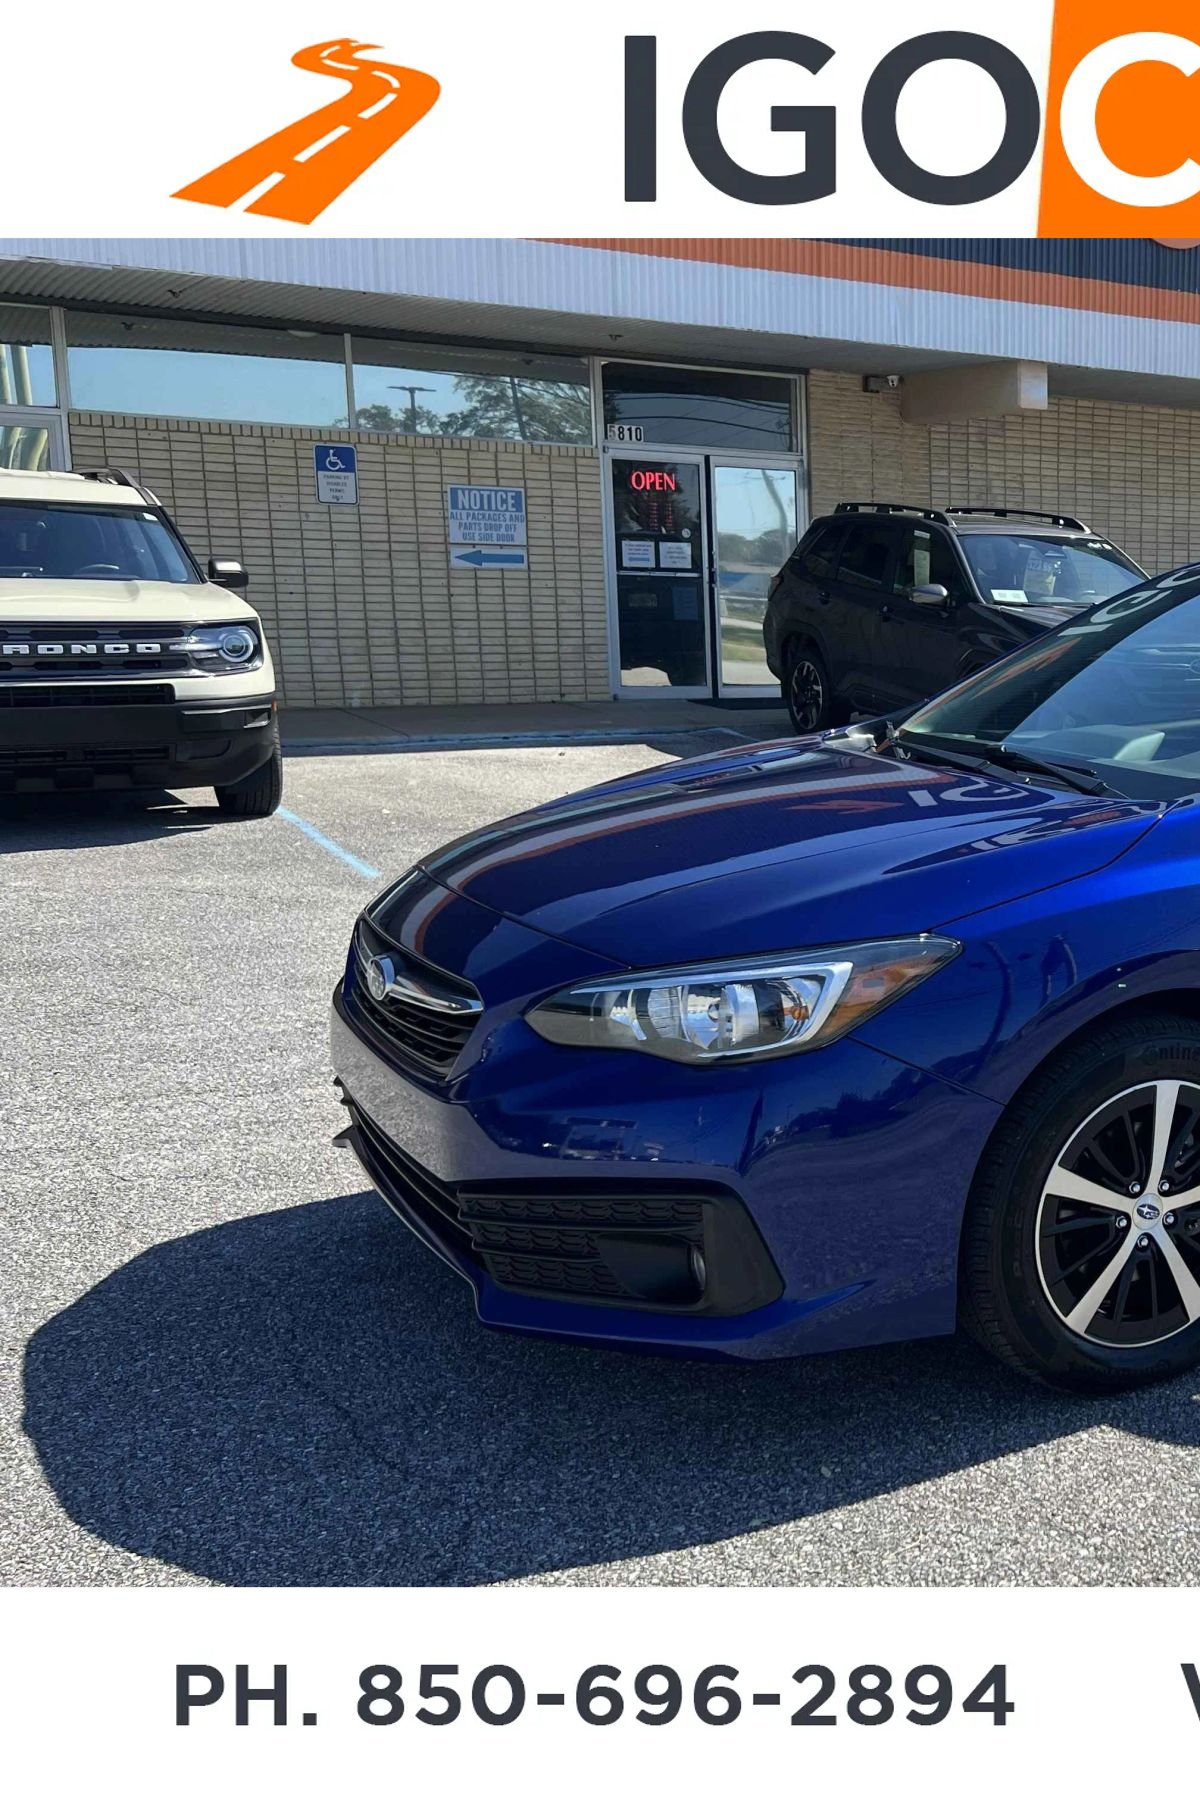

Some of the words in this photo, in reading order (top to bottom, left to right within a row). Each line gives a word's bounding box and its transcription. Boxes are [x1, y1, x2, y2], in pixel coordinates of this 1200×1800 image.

[608, 425, 642, 441] 5810
[630, 471, 677, 491] OPEN
[457, 489, 516, 511] NOTICE
[450, 511, 463, 520] ALL
[466, 511, 507, 522] PACKAGES
[509, 514, 525, 523] AND
[459, 521, 482, 531] PARTS
[484, 523, 503, 532] DROP
[505, 524, 517, 533] OFF
[462, 532, 476, 541] USE
[479, 532, 495, 542] SIDE
[496, 533, 515, 542] DOOR
